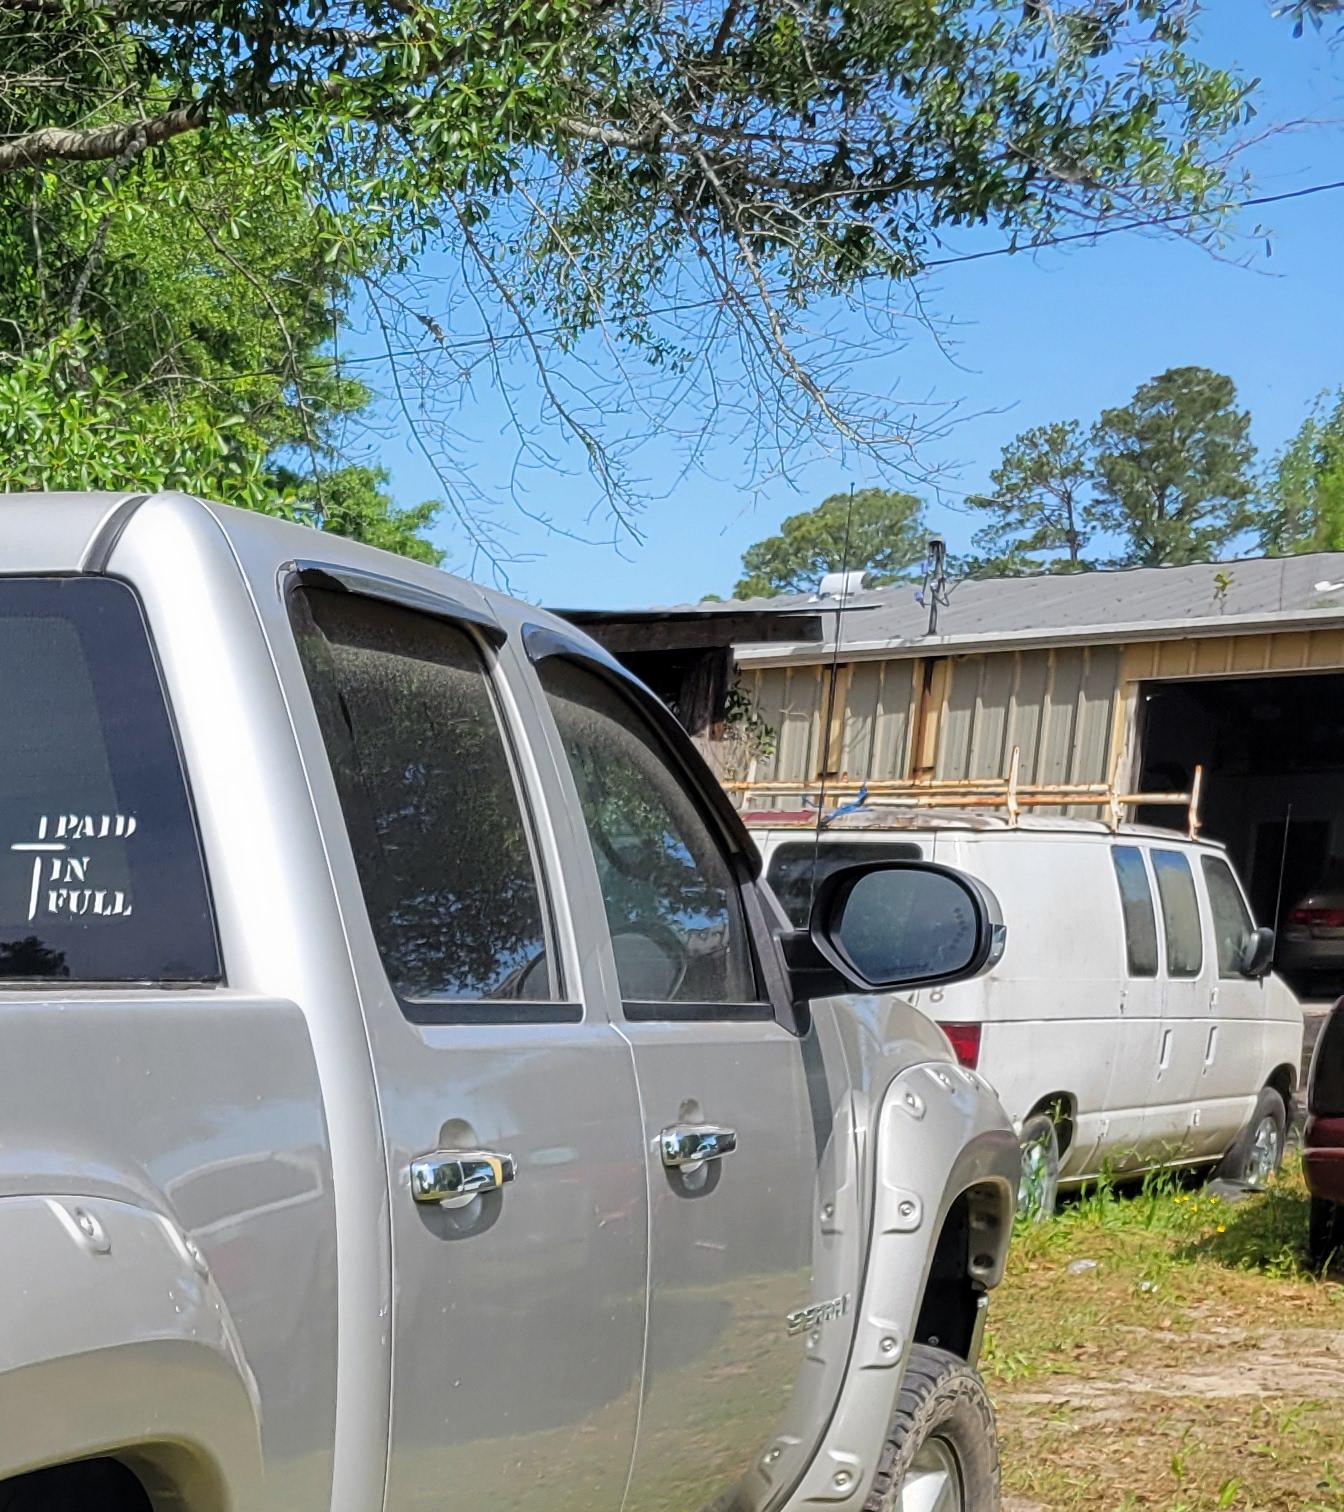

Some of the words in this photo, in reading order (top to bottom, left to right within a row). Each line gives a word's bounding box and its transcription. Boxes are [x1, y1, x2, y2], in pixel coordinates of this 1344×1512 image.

[54, 813, 137, 839] PAID
[49, 856, 90, 882] IN
[47, 888, 133, 916] FULL
